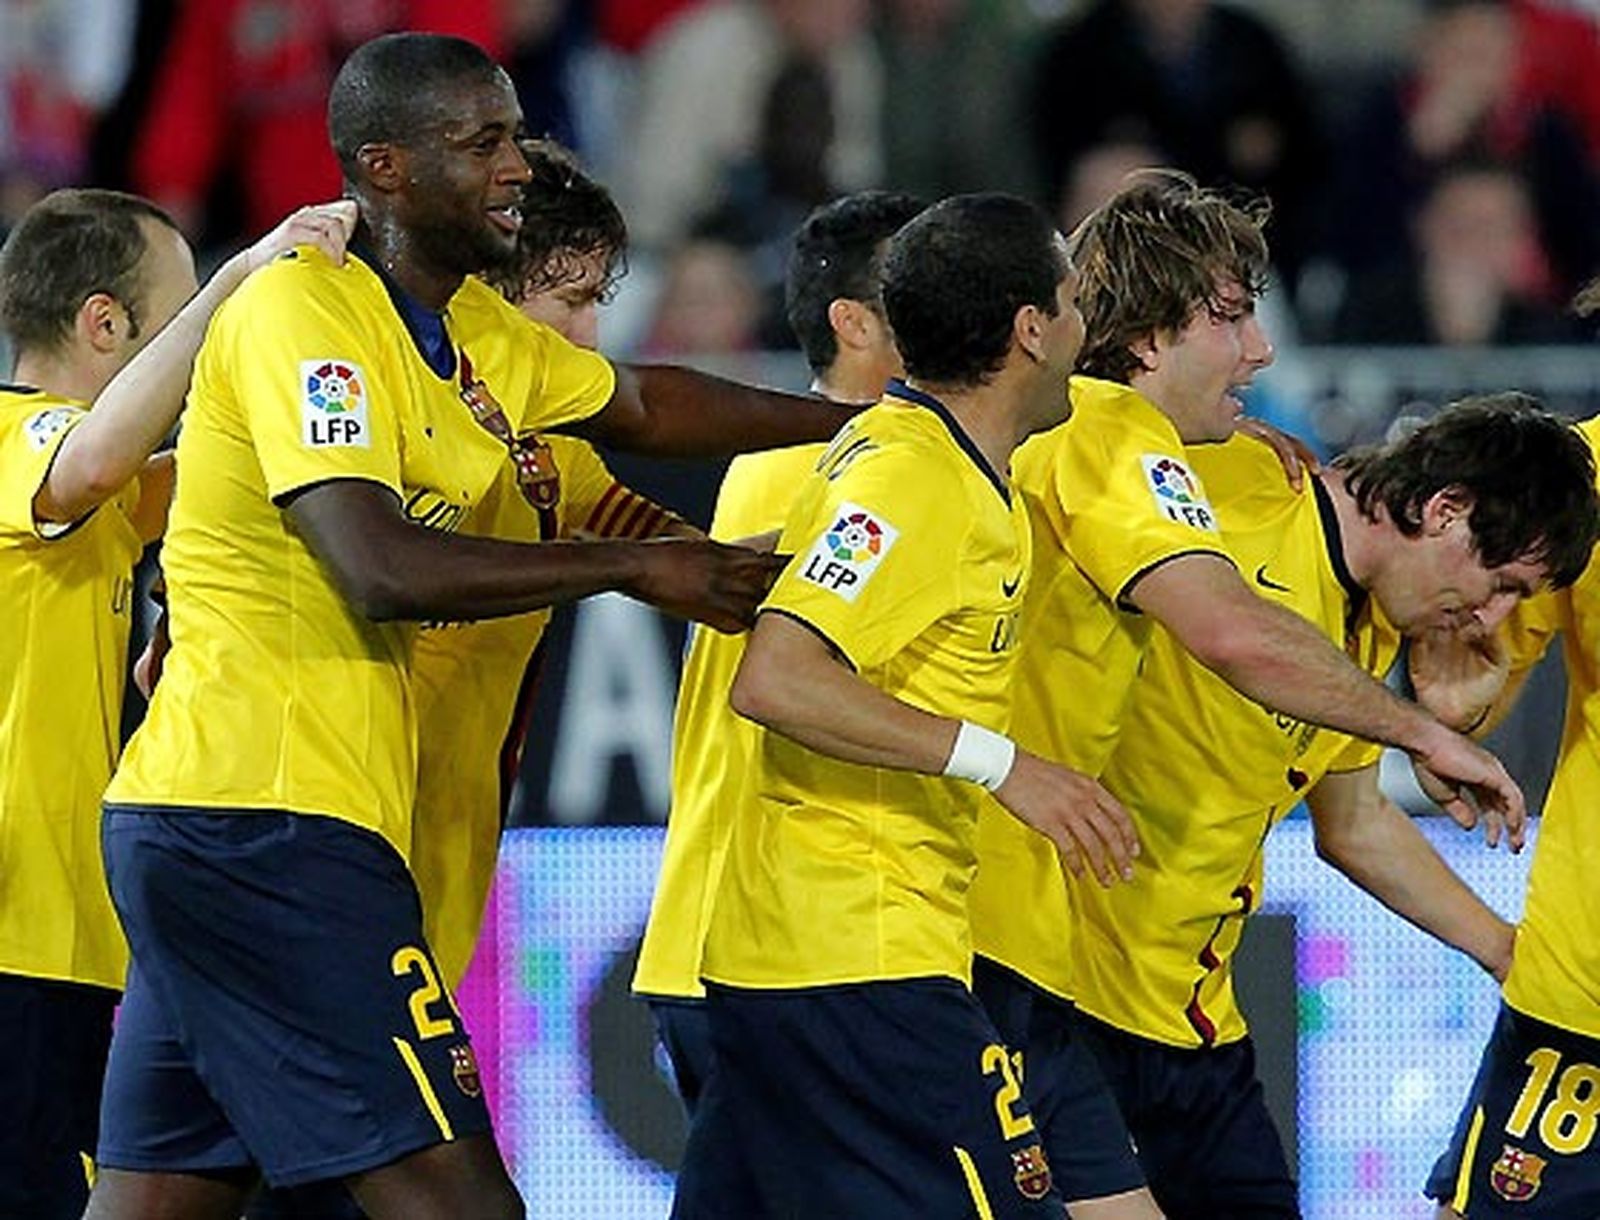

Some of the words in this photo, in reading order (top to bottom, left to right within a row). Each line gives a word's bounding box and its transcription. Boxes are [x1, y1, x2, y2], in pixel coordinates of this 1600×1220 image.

[311, 417, 361, 444] LFP
[805, 554, 858, 589] LFP
[1505, 1047, 1600, 1155] 18
